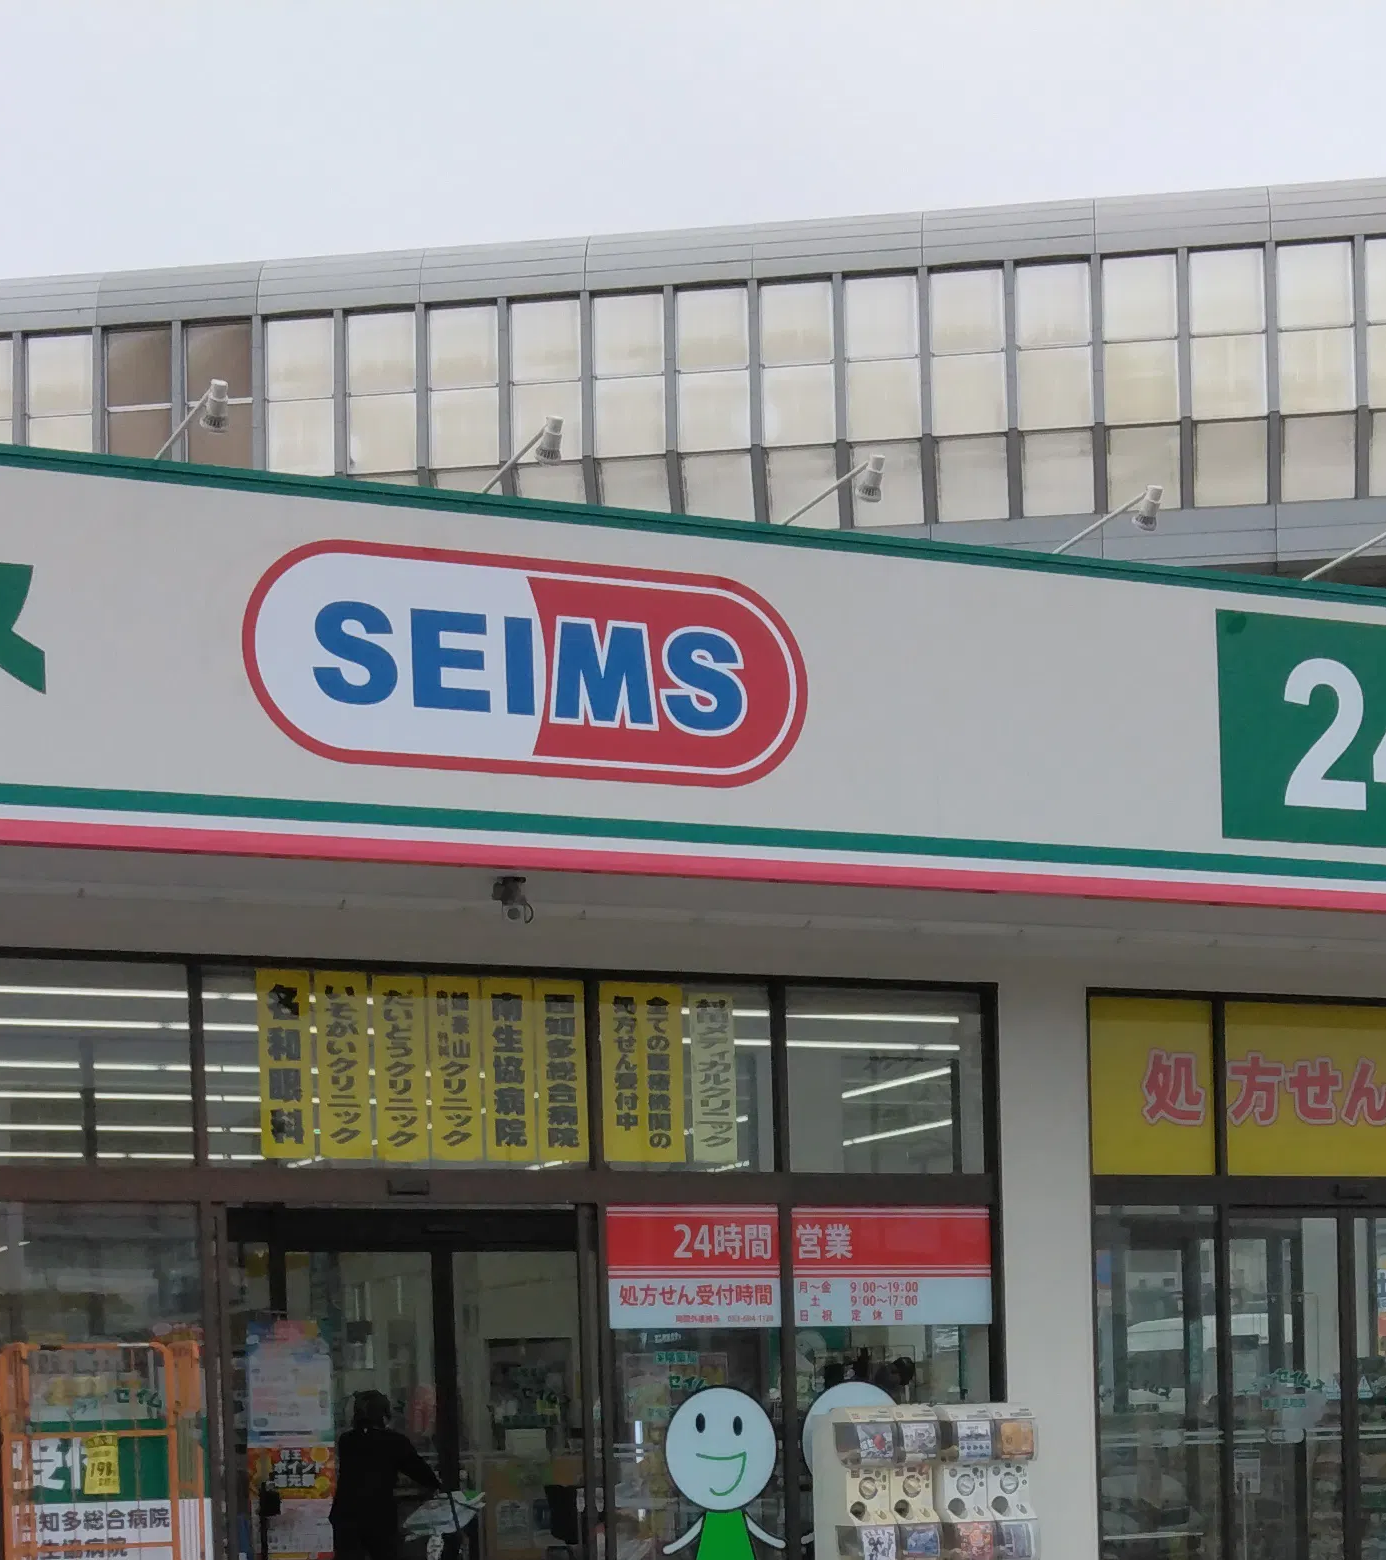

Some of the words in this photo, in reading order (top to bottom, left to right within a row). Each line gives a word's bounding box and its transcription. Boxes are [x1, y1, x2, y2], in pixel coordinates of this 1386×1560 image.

[311, 600, 749, 738] SEIMS
[267, 983, 305, 1145] 名和眼科
[324, 984, 362, 1145] いそがいクリニック
[612, 995, 640, 1132] 処方せん受付中
[619, 1283, 773, 1307] 処方せん受付時間
[672, 1222, 773, 1260] 24時間
[794, 1223, 854, 1260] 営業
